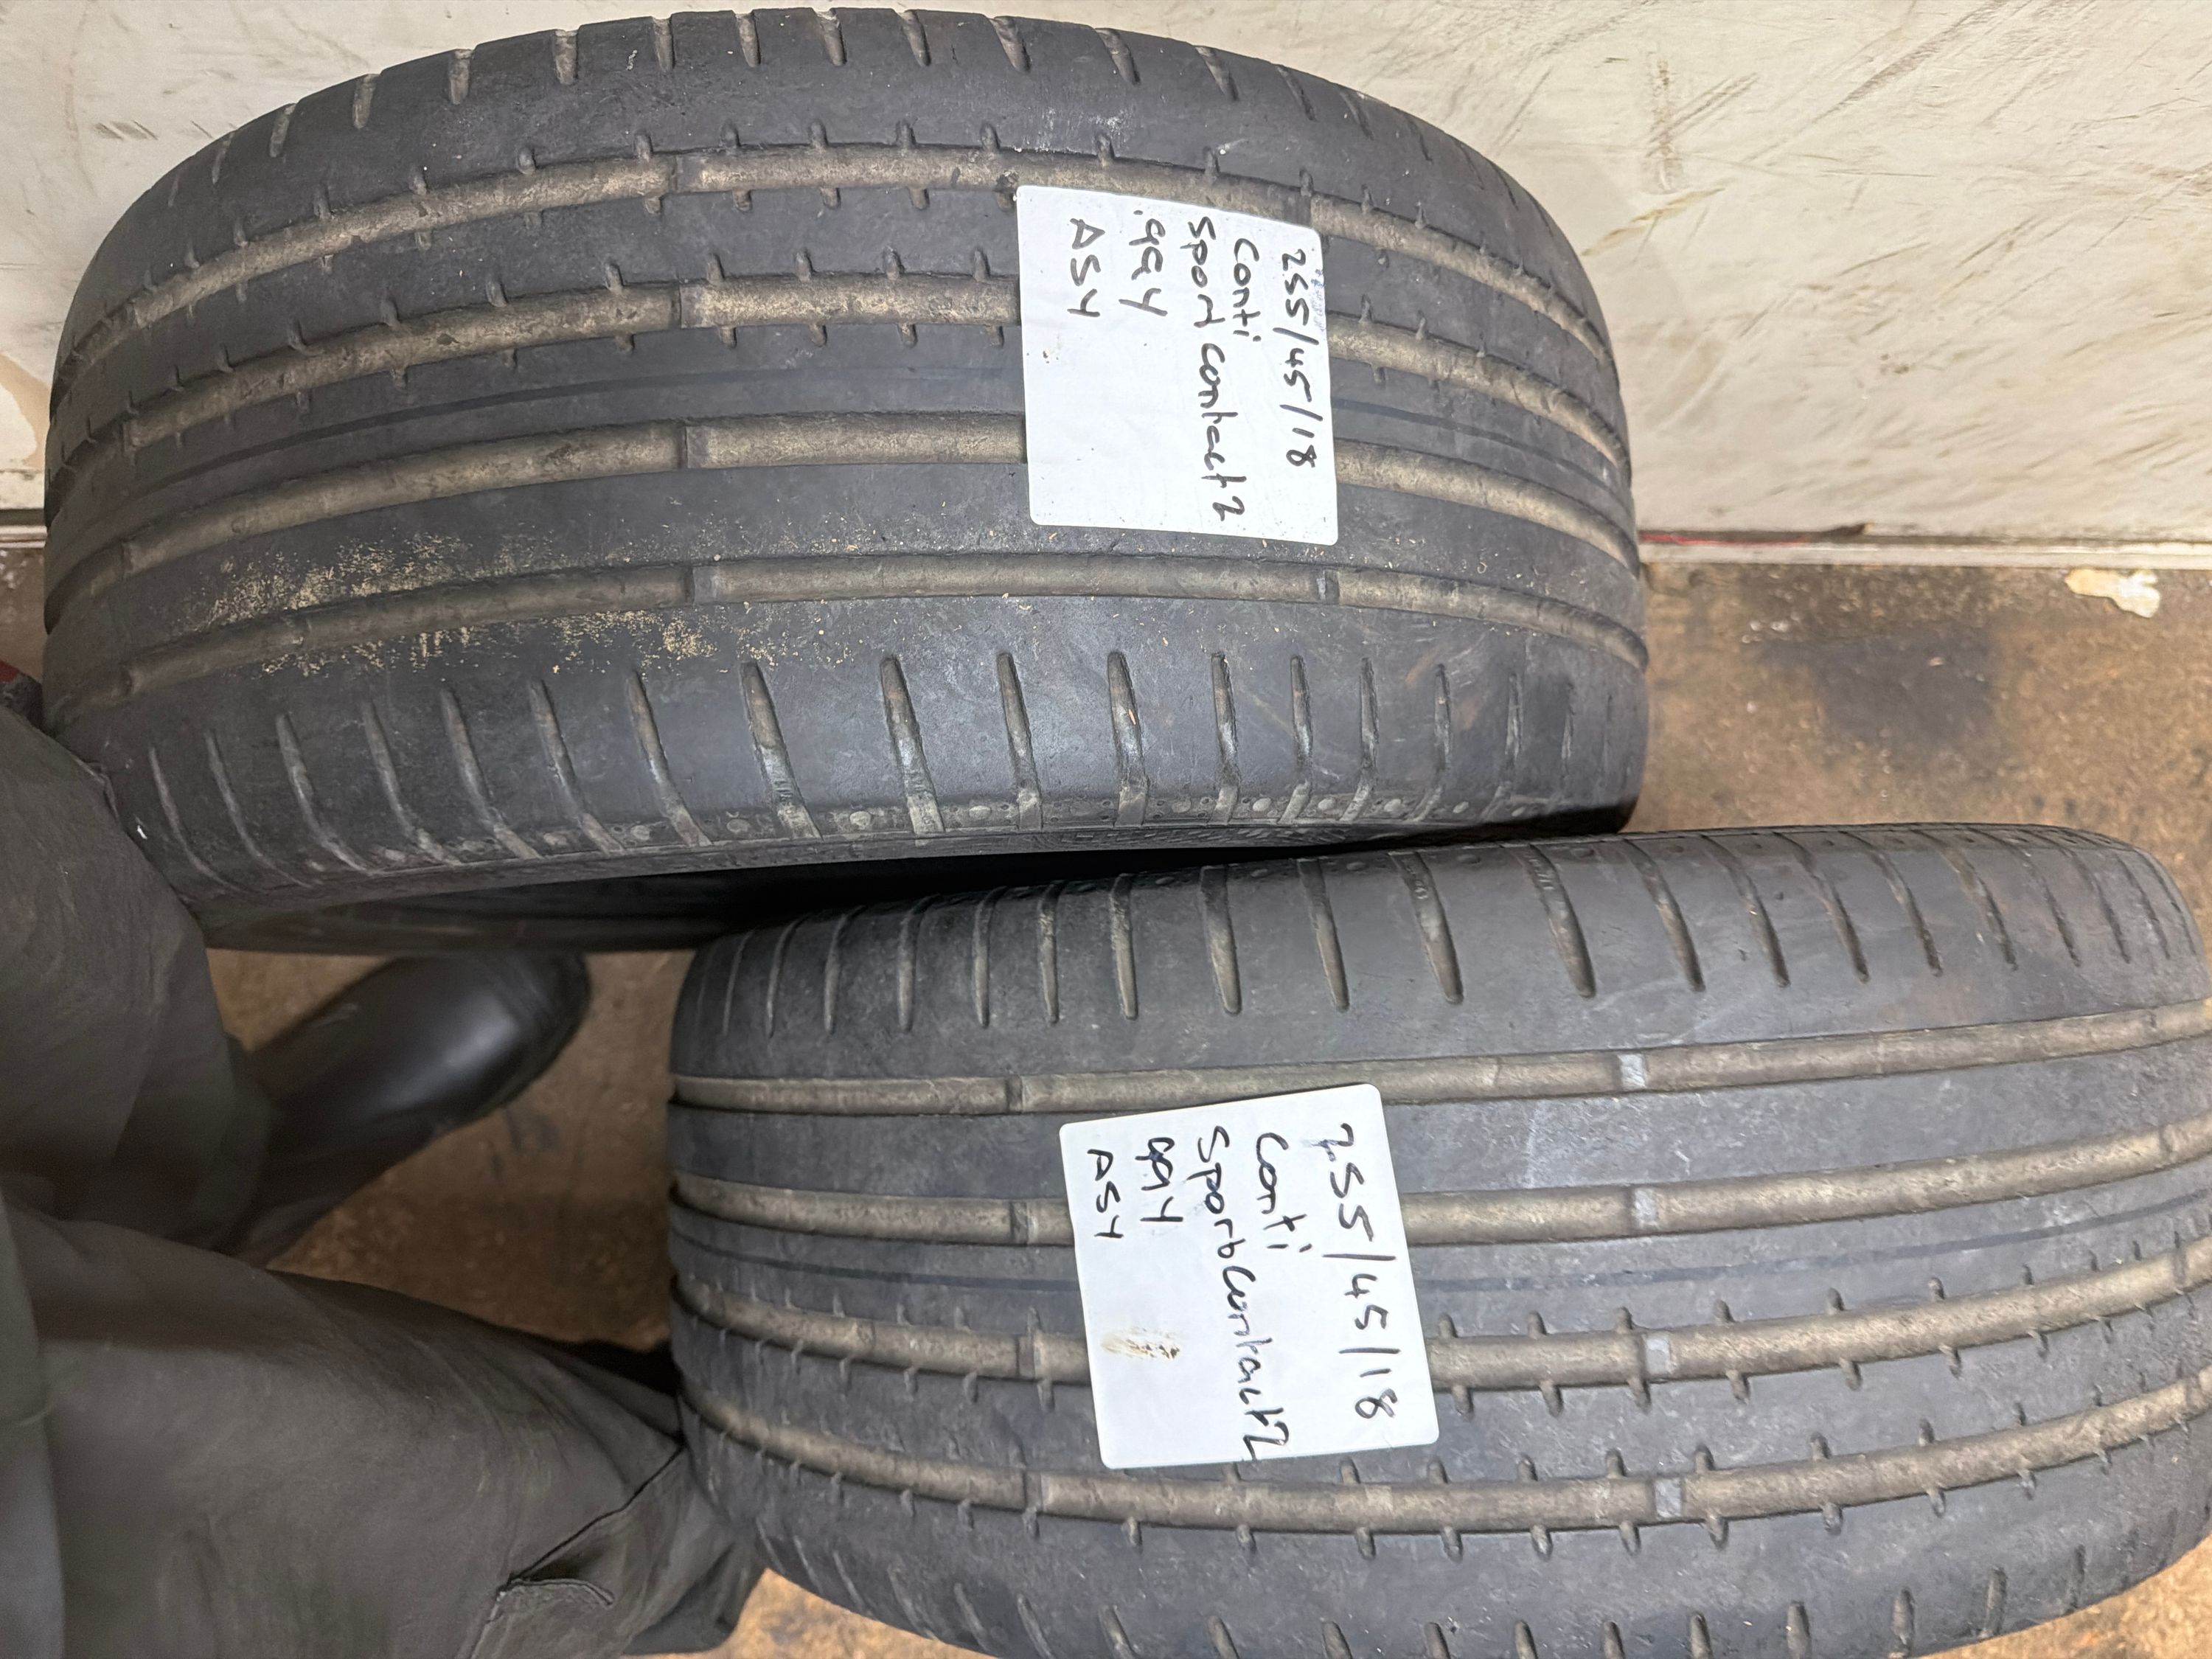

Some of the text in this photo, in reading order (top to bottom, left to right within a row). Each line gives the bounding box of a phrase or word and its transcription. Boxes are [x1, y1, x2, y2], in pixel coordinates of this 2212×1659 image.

[1233, 237, 1262, 343] Conti
[1273, 248, 1324, 469] 255/45/18
[1087, 1148, 1124, 1239] ASY
[1256, 1132, 1312, 1253] Conti
[1320, 1122, 1401, 1419] 255/45/18
